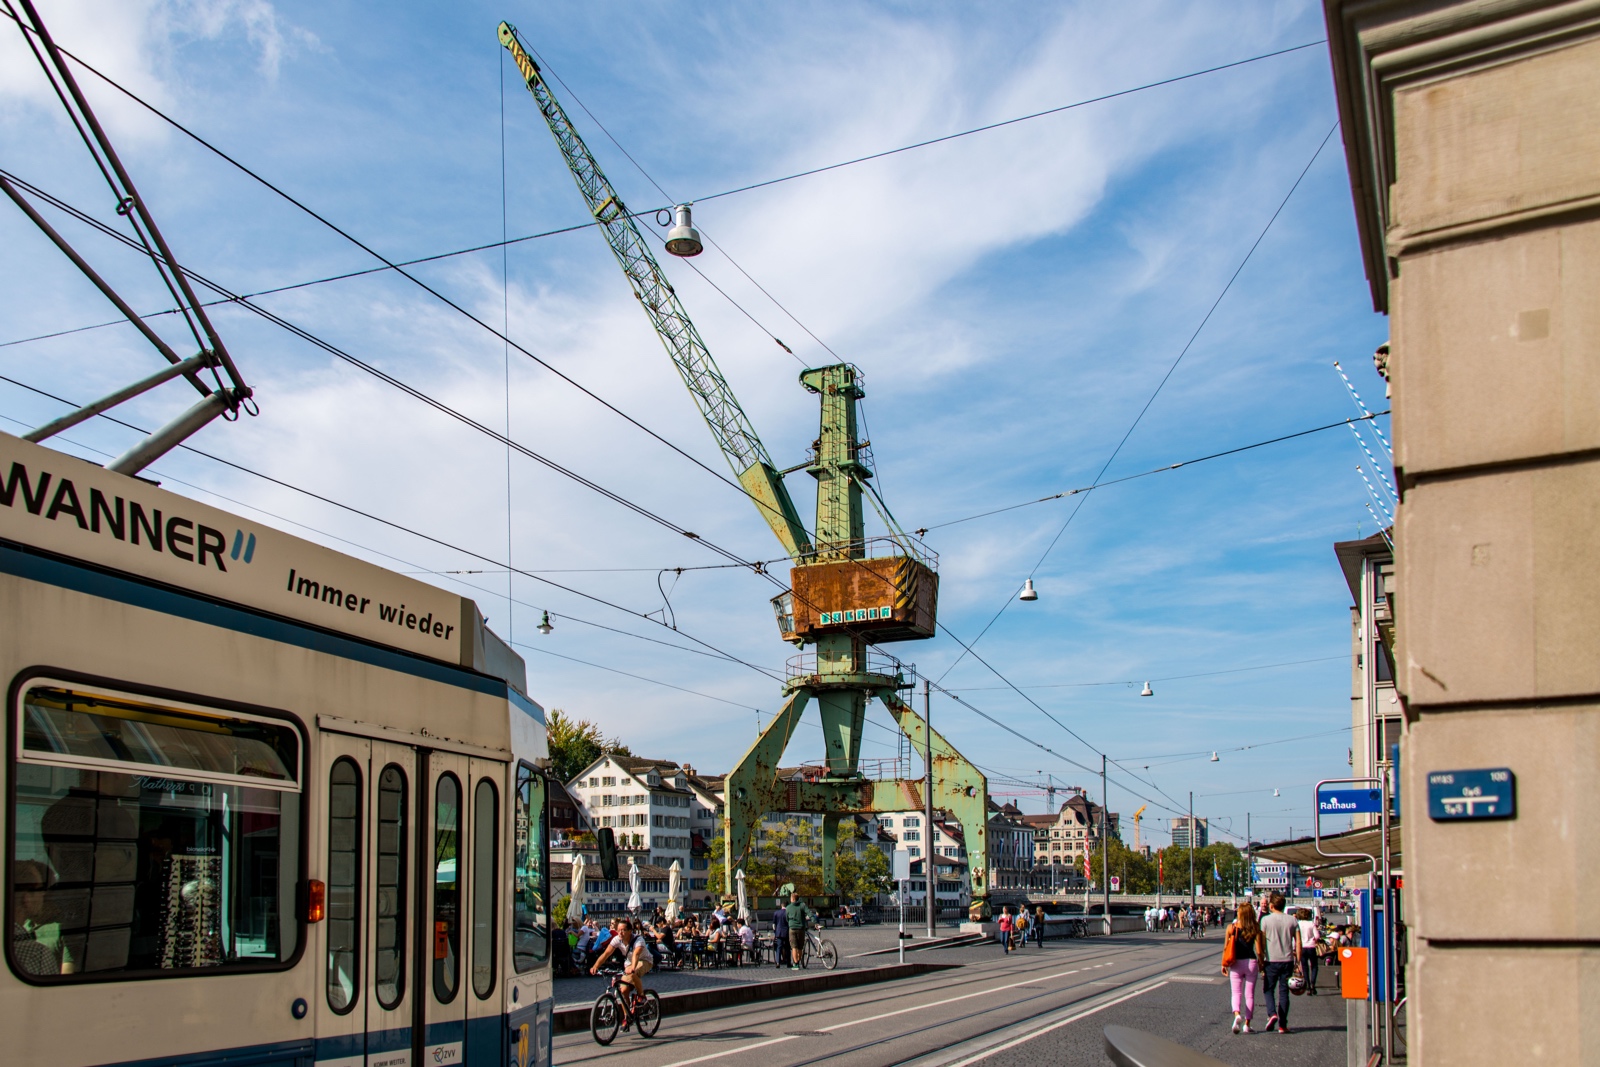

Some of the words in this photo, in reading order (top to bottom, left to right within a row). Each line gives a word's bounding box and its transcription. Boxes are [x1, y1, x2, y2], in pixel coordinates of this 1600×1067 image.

[0, 461, 228, 573] WANNER
[287, 568, 371, 615] Immer
[378, 602, 455, 641] wieder
[1490, 771, 1508, 783] 100
[1320, 802, 1357, 810] Rathaus
[443, 1049, 456, 1059] ZVV
